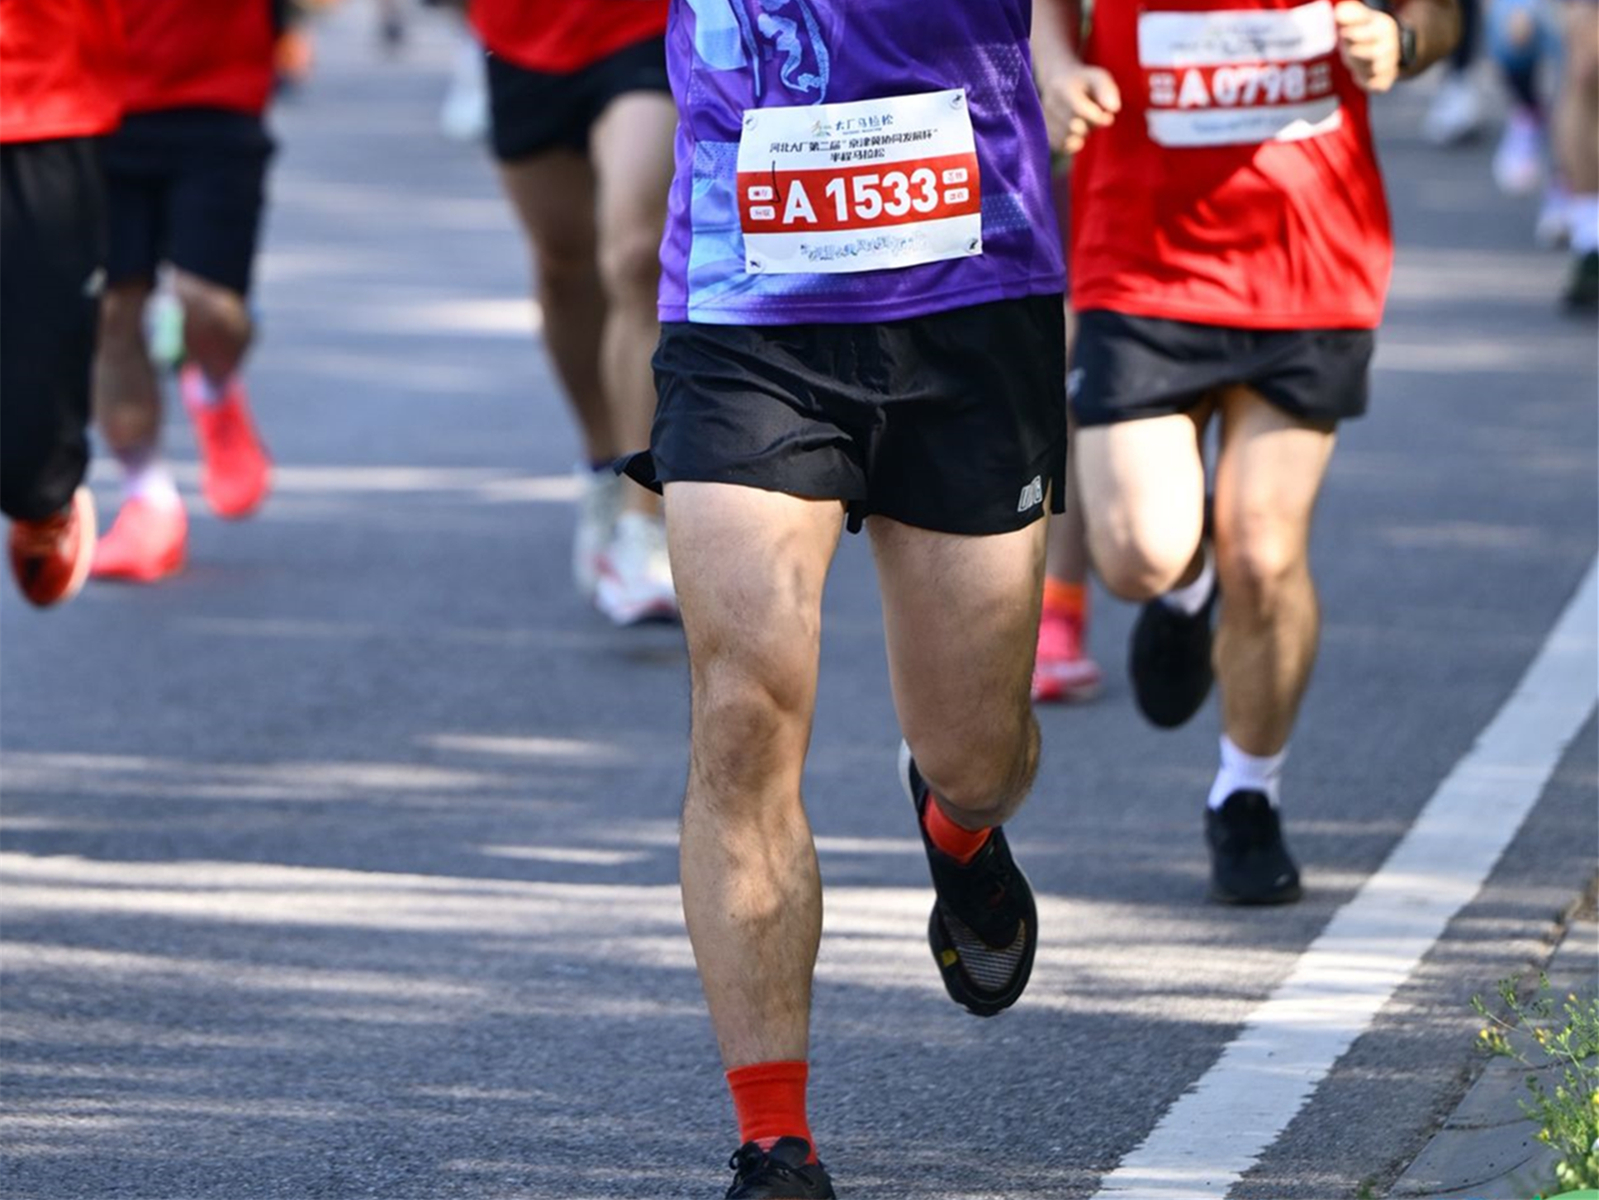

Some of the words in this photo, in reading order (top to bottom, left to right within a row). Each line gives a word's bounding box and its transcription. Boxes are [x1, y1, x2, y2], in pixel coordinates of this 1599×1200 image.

[835, 114, 894, 131] 大厂马拉松
[830, 148, 885, 162] 半程马拉松
